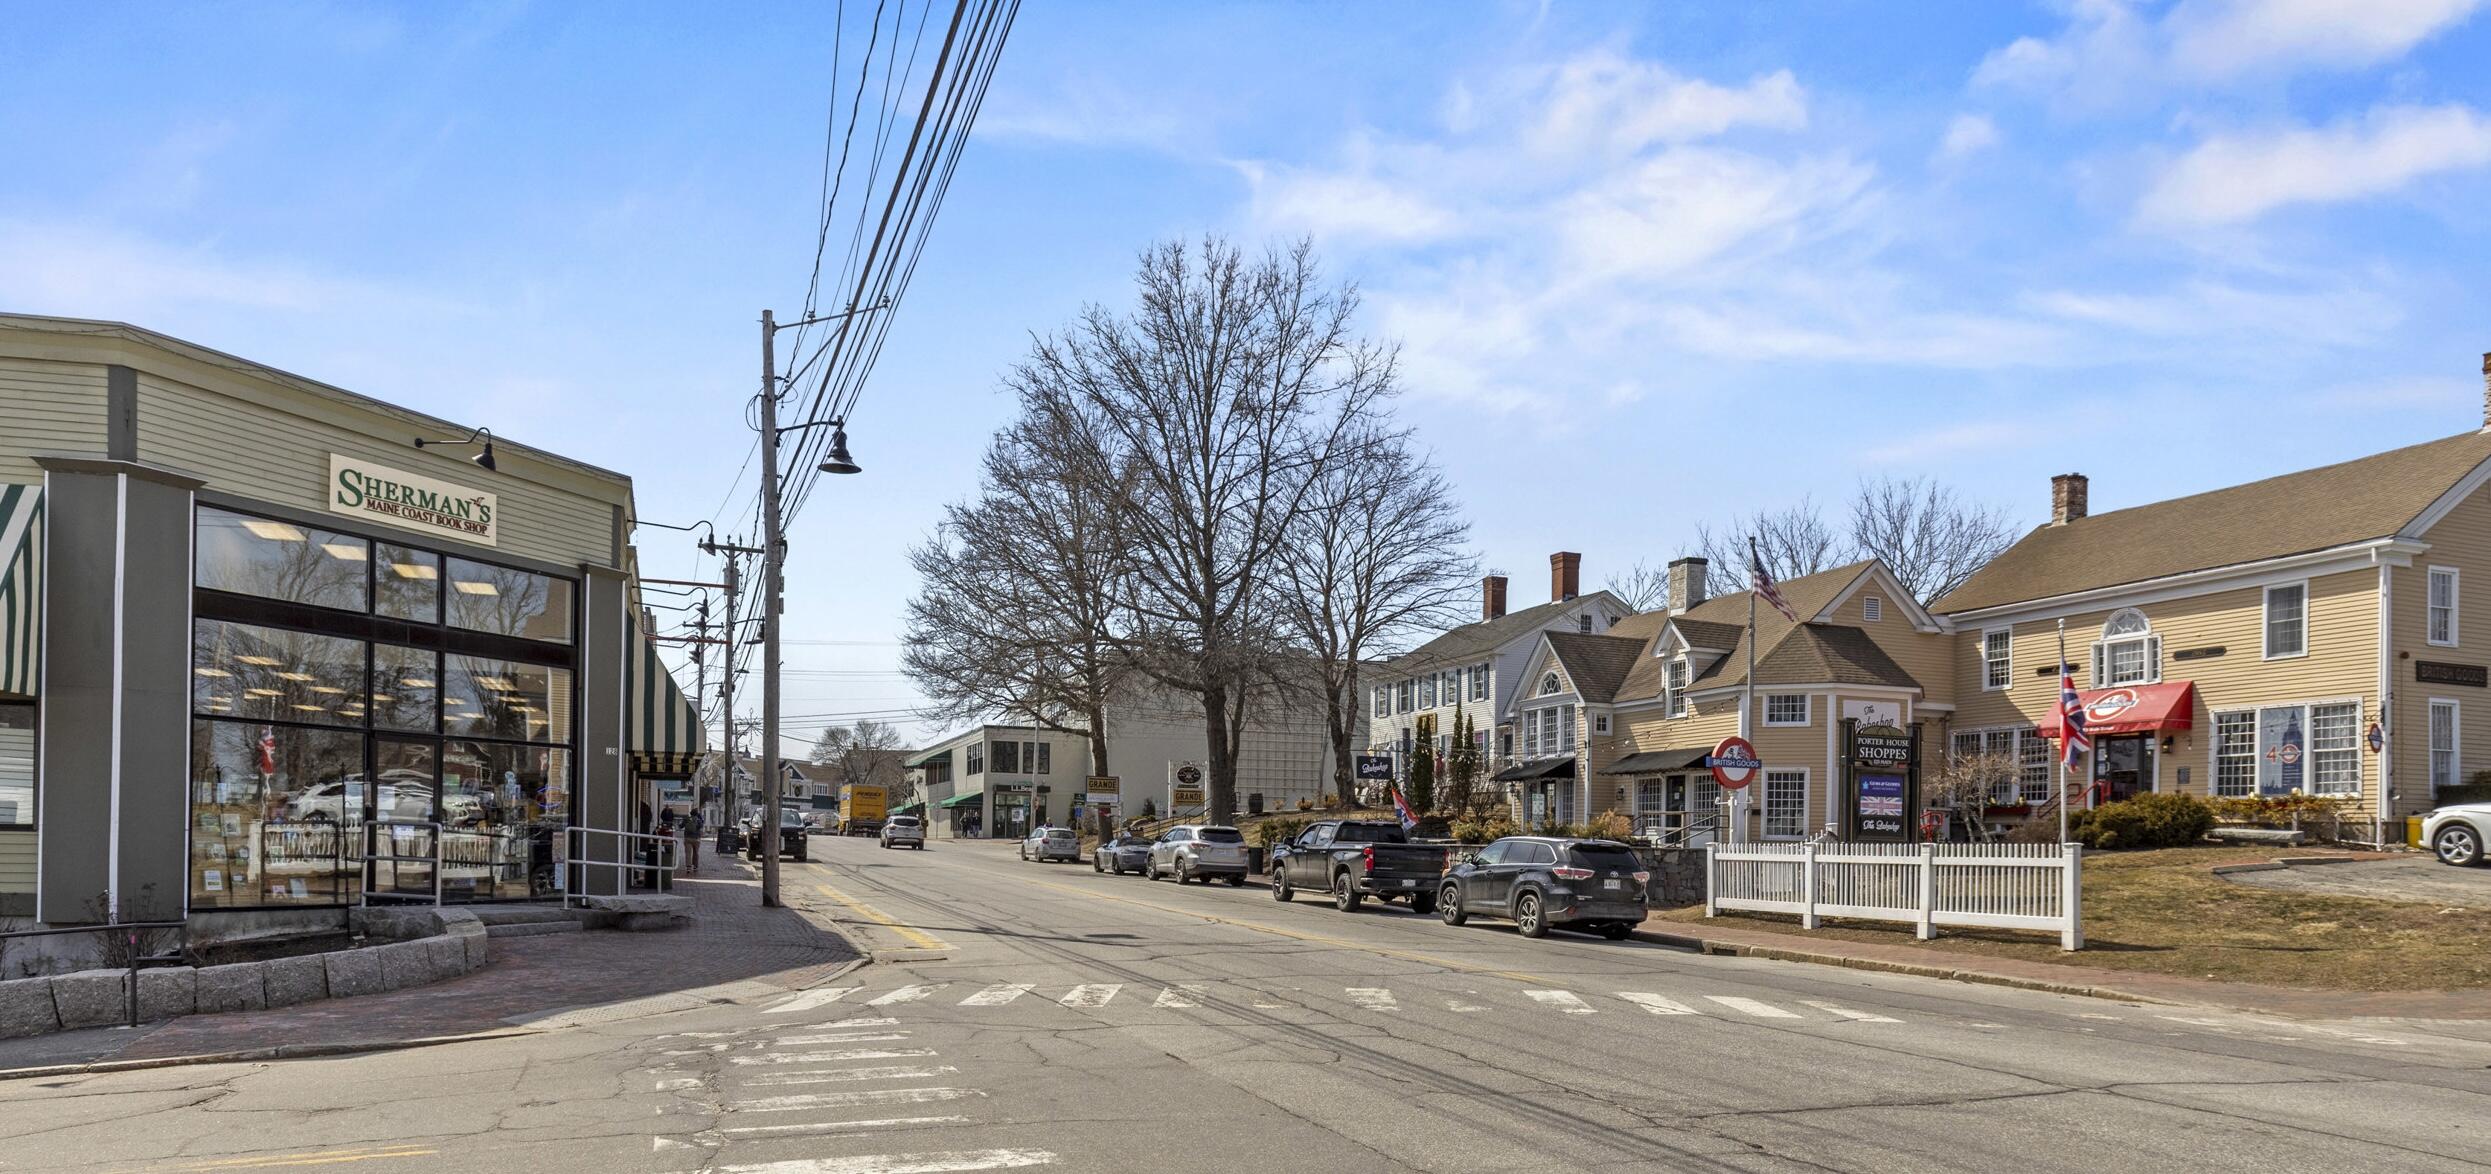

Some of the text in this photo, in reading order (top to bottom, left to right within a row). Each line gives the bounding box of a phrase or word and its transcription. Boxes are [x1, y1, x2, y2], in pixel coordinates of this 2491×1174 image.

[338, 469, 491, 523] SHERMAN'S
[366, 499, 488, 535] MAINE COAST BOOK SHOP
[1864, 705, 1875, 715] The
[1857, 737, 1909, 747] PORTER HOUSE
[1859, 746, 1907, 760] SHOPPES
[1713, 758, 1759, 768] BRITISH GOODS
[1088, 780, 1117, 789] GRANDE
[1175, 792, 1203, 801] GRANDE
[1863, 819, 1875, 830] The
